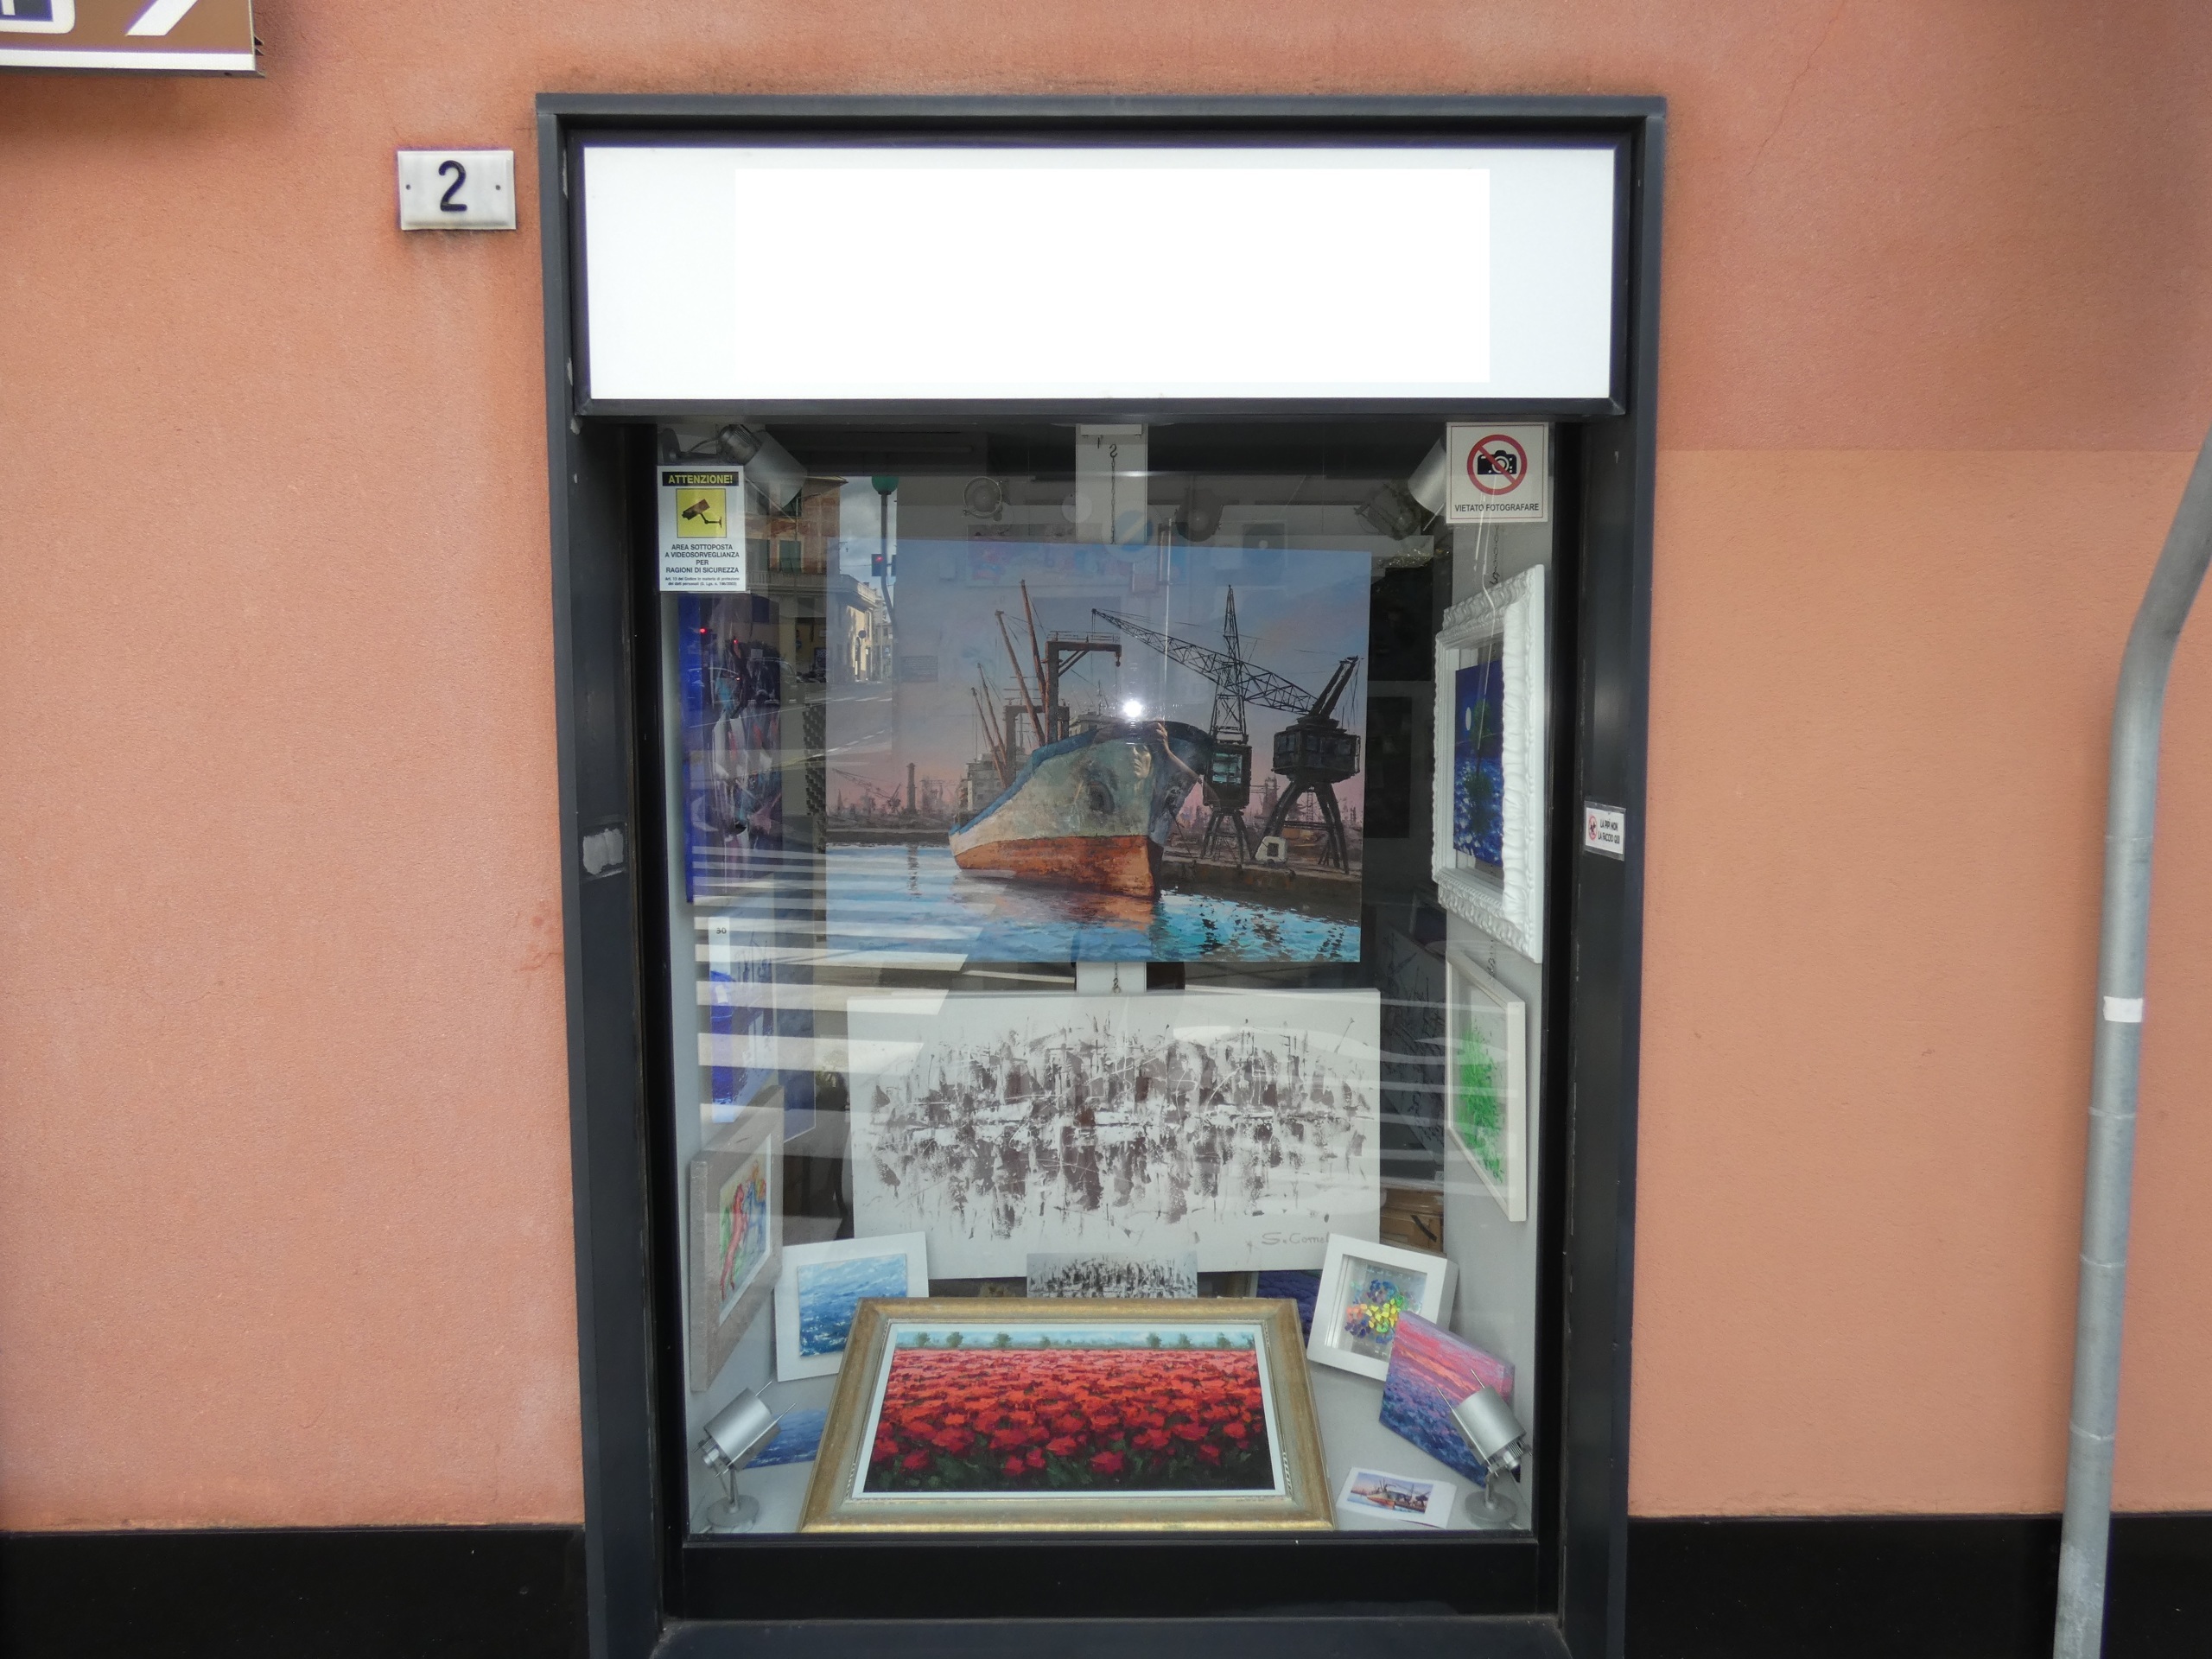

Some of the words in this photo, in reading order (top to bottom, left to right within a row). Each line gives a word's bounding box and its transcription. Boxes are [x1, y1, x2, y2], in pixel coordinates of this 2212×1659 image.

[438, 160, 467, 212] 2
[668, 474, 734, 484] ATTENZIONE!
[1454, 504, 1484, 512] VIETATO
[1486, 503, 1540, 512] FOTOGRAFARE
